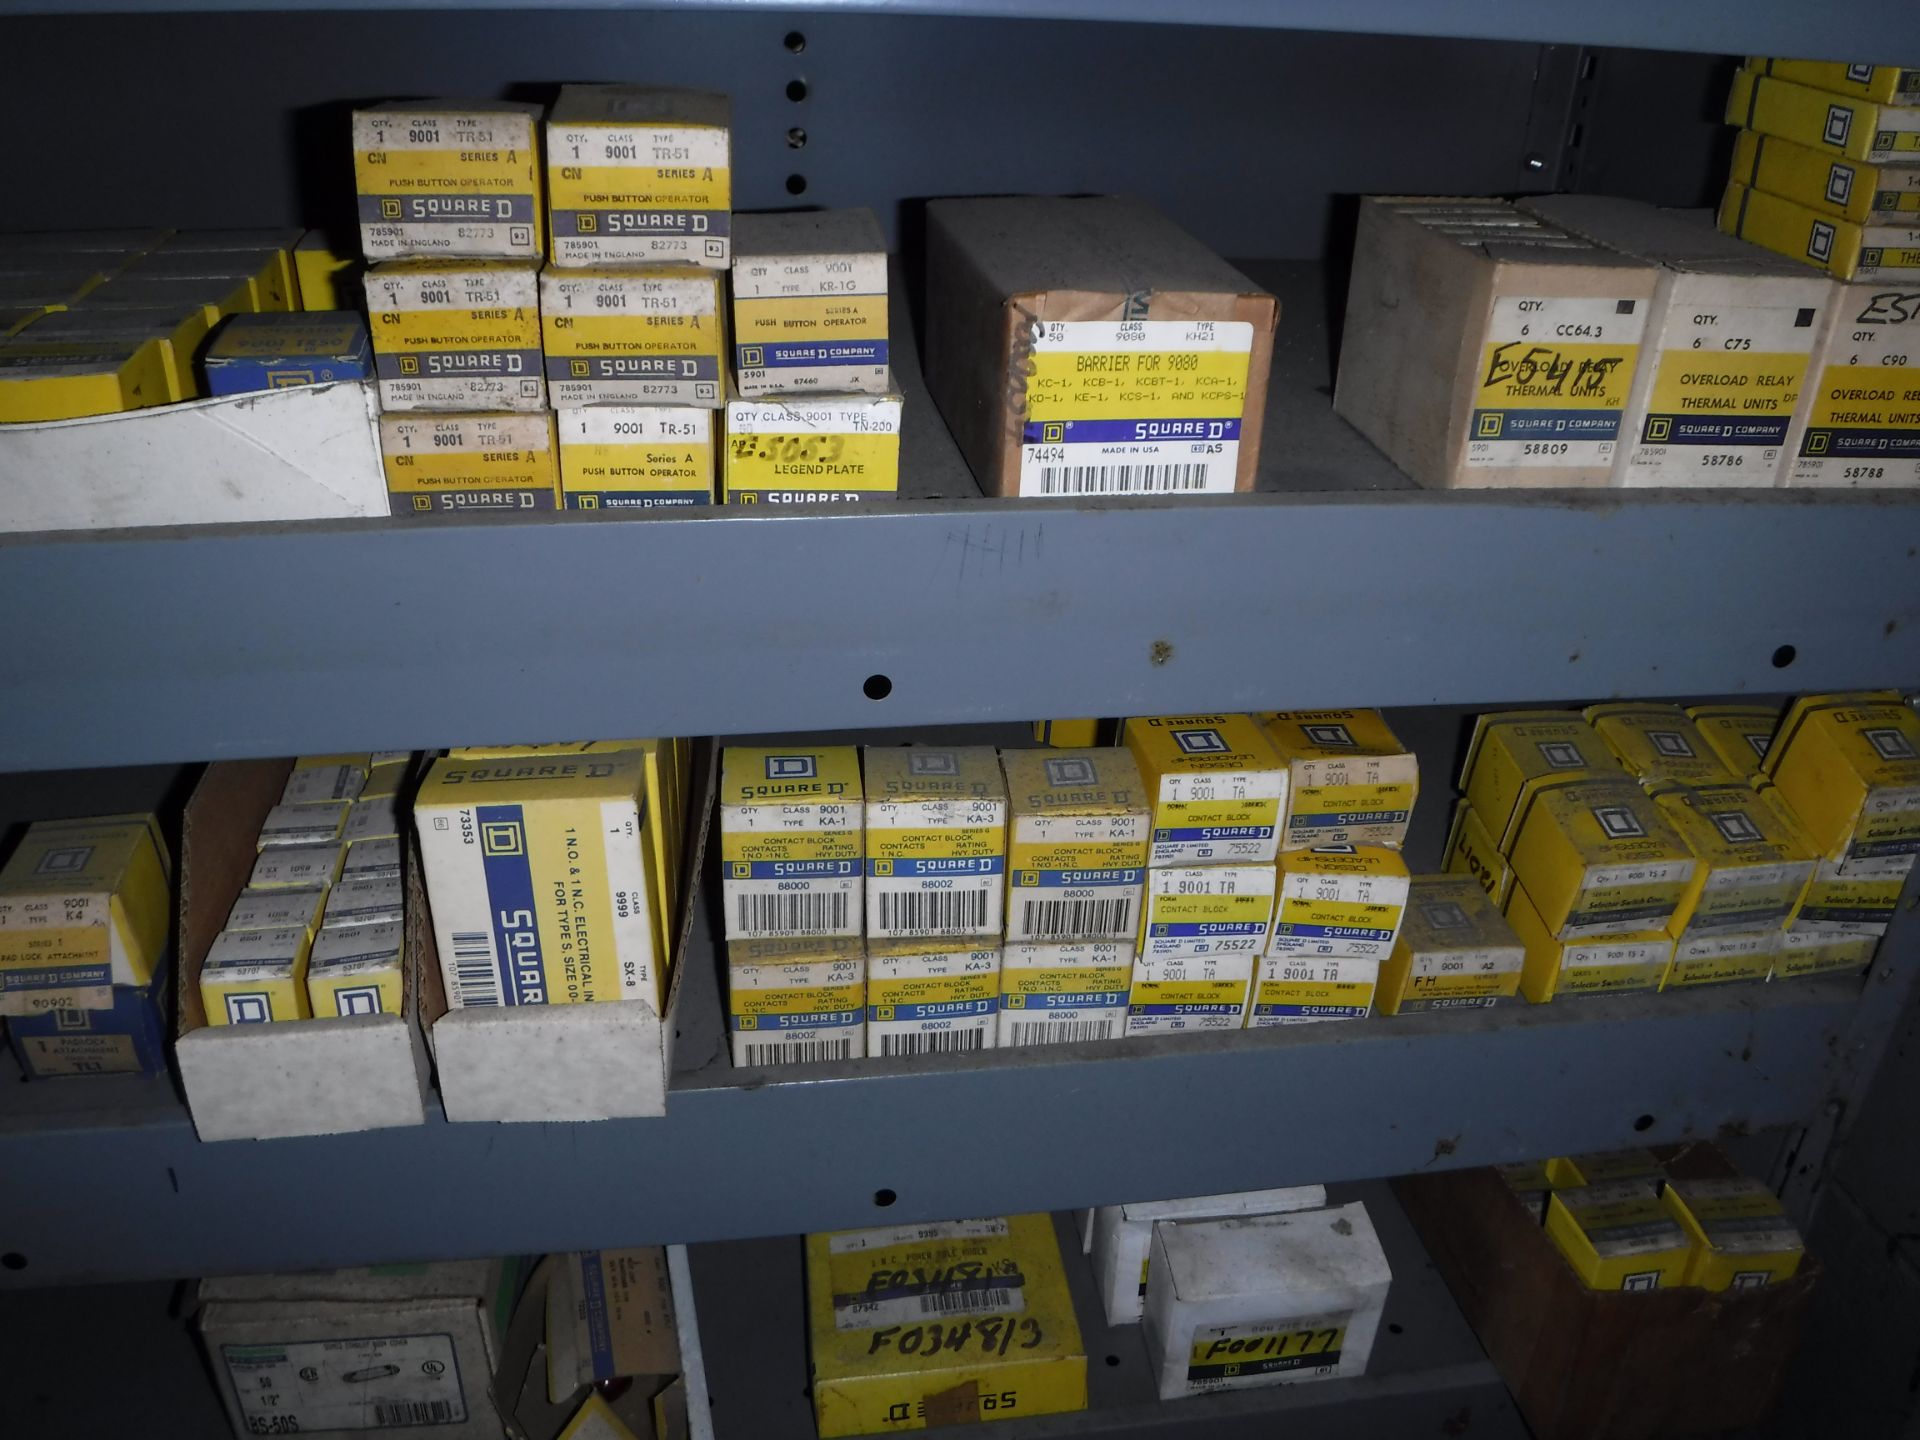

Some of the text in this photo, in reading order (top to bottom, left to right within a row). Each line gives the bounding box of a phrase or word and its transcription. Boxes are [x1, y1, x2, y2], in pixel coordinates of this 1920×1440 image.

[409, 130, 439, 143] 9001
[367, 151, 517, 164] CN SERIES A
[605, 145, 637, 159] 9001
[561, 168, 713, 181] CN SERIES A
[417, 179, 457, 187] BUTTON
[460, 178, 513, 186] OPERATOR
[413, 200, 512, 217] SQUARE D
[608, 215, 707, 231] SQUARE D
[370, 228, 494, 239] 785901 82773
[785, 266, 809, 274] CLASS
[820, 281, 856, 292] KR-1G
[421, 291, 450, 303] 9001
[1519, 301, 1543, 311] QTY.
[824, 318, 866, 326] OPERATOR
[1694, 315, 1717, 325] QTY.
[1051, 322, 1214, 332] QTY CLASS TYPE
[1521, 324, 1602, 337] 6 CC64.3
[1049, 332, 1214, 342] 50 9080 KH21
[1693, 338, 1750, 350] 6 C75
[776, 348, 875, 359] SQUARE D COMPANY
[428, 354, 522, 372] SQUARE D
[1077, 355, 1198, 372] BARRIER FOR 9080
[1882, 356, 1907, 365] C90
[601, 361, 697, 376] SQUARE D
[1037, 377, 1237, 388] KC-1, KCB-1, KCBT-1, KCA-1,
[1680, 375, 1794, 386] OVERLOAD RELAY
[1506, 385, 1606, 397] THERMAL UNITS
[1831, 390, 1894, 400] OVERLOAD
[1075, 392, 1109, 402] KE-1,
[1119, 392, 1161, 401] KCS-1,
[1172, 392, 1194, 400] AND
[1202, 392, 1245, 400] KCPS-1
[1681, 398, 1777, 409] THERMAL UNITS
[736, 412, 866, 421] QTY CLASS 9001 TYPE
[1830, 413, 1882, 423] THERMAL
[581, 422, 696, 435] 1 9001 TR-51
[853, 422, 891, 431] TN-200
[1511, 420, 1617, 431] SQUARE D COMPANY
[1679, 425, 1780, 437] SQUARE D COMPANY
[1135, 423, 1222, 440] SQUARE D
[434, 434, 463, 446] 9001
[1028, 448, 1064, 464] 74494
[1206, 444, 1222, 454] AS
[1524, 444, 1568, 455] 58809
[646, 454, 693, 463] Series A
[1702, 455, 1742, 466] 58786
[583, 468, 697, 477] PUSH BUTTON OPERATOR
[775, 465, 864, 474] LEGEND PLATE
[1844, 468, 1884, 478] 58788
[742, 783, 844, 799] SQUARE D
[1190, 786, 1245, 800] 9001 TA
[820, 806, 844, 814] 9001
[972, 803, 997, 812] 9001
[820, 818, 846, 826] KA-1
[967, 815, 994, 824] KA-3
[1112, 818, 1135, 826] 9001
[1338, 811, 1405, 824] SQUARE D
[460, 810, 474, 844] 73353
[1109, 829, 1135, 838] KA-1
[1202, 827, 1271, 840] SQUARE D
[567, 838, 579, 863] N.O.
[774, 861, 850, 875] SQUARE D
[916, 859, 992, 872] SQUARE D
[1062, 870, 1136, 883] SQUARE D
[778, 882, 809, 890] 88000
[922, 880, 953, 888] 88002
[1178, 881, 1235, 894] 9001 TA
[554, 882, 565, 905] FOR
[1063, 889, 1094, 898] 88000
[64, 899, 89, 908] 9001
[572, 889, 583, 912] N.C.
[632, 892, 640, 914] CLASS
[558, 910, 570, 939] TYPE
[616, 892, 628, 917] 9999
[624, 962, 635, 986] SX-8
[1324, 926, 1391, 941] SQUARE D
[1215, 940, 1256, 950] 75522
[575, 916, 592, 986] ELECTRICAL
[564, 957, 576, 980] SIZE
[921, 1021, 951, 1030] 88002
